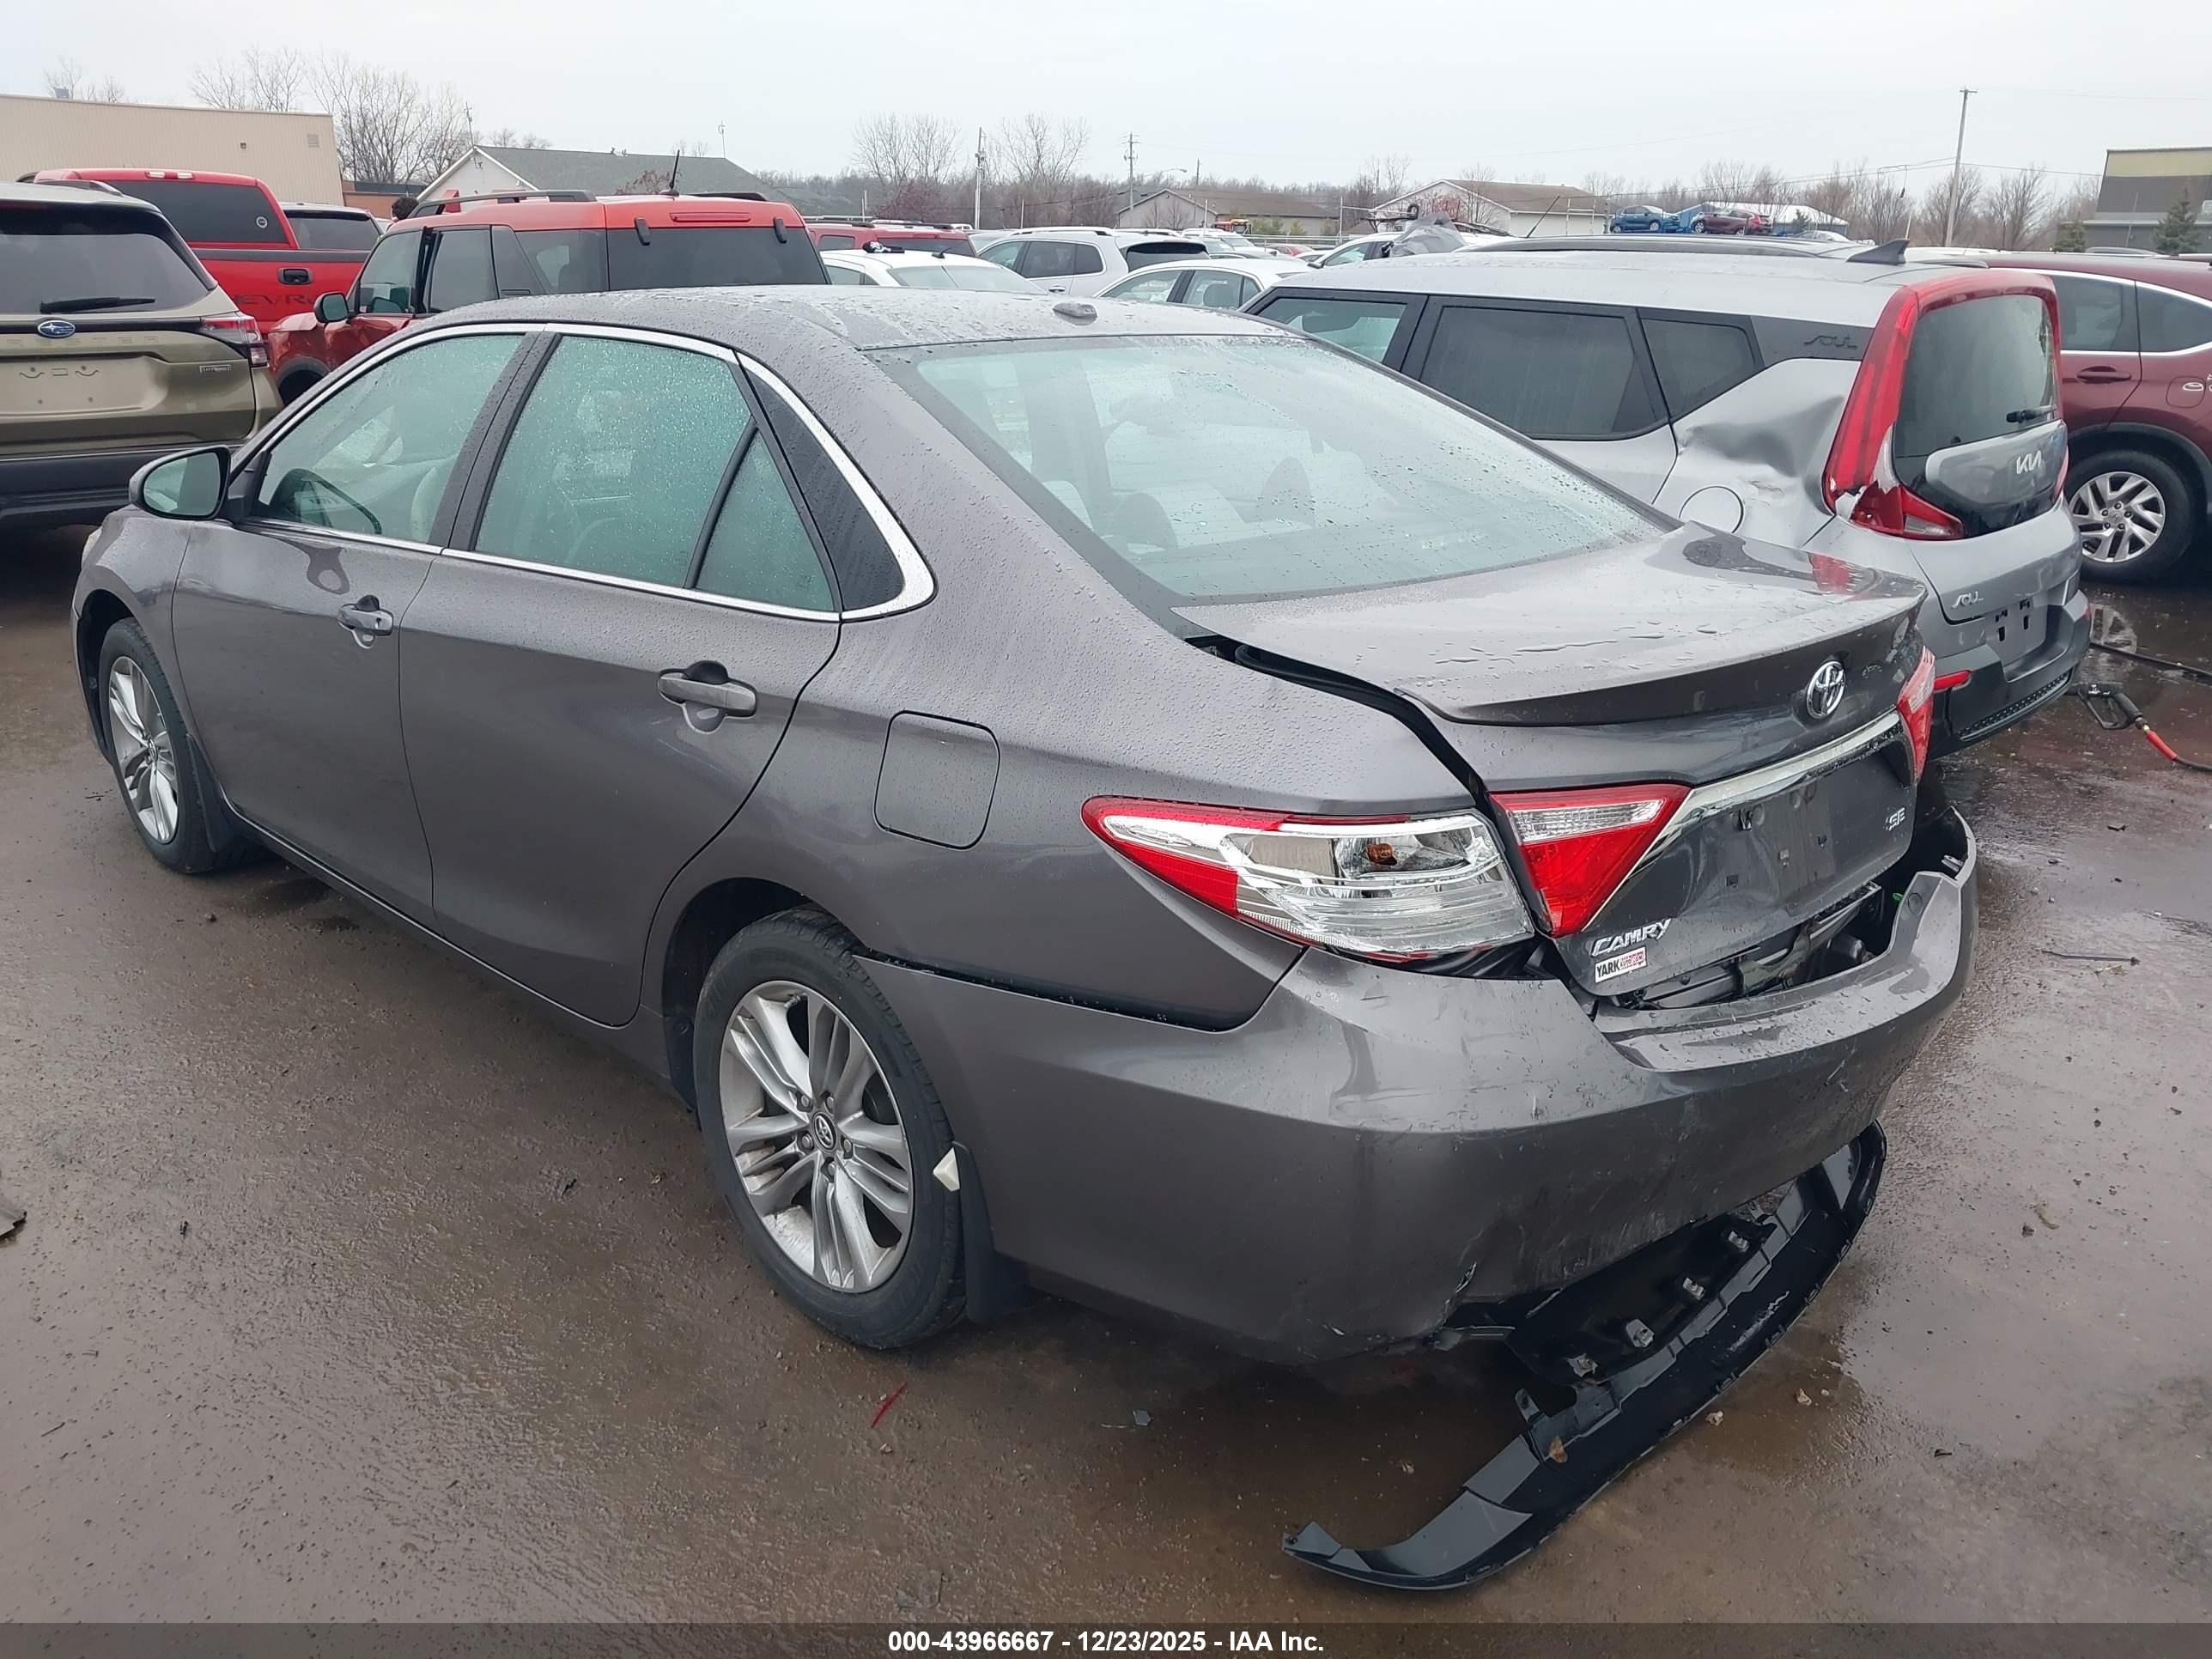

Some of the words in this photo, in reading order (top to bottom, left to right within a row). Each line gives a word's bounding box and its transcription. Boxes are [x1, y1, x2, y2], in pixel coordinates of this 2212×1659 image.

[2016, 449, 2043, 475] KIA
[1591, 917, 1672, 957] CAMRY
[1596, 959, 1620, 978] YARK
